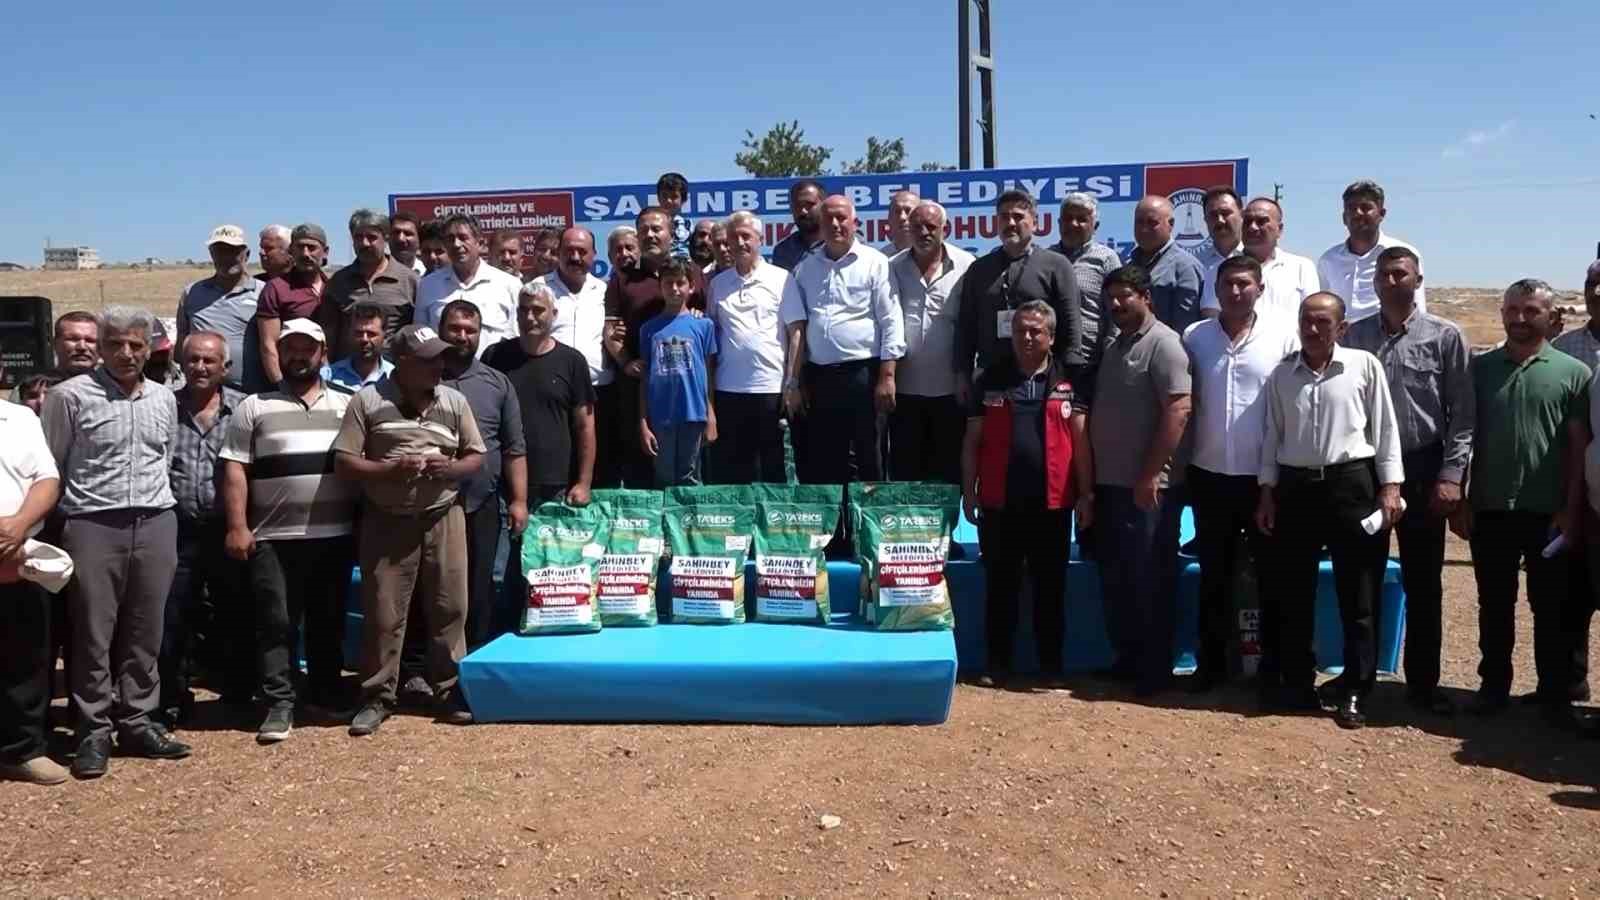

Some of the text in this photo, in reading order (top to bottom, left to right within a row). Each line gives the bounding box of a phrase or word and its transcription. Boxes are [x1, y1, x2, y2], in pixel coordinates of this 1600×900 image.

[519, 202, 535, 213] VE
[583, 188, 790, 220] ŞAİNBE
[697, 514, 735, 524] TAREKS
[784, 513, 822, 522] TAREKS
[900, 515, 940, 526] TAREKS
